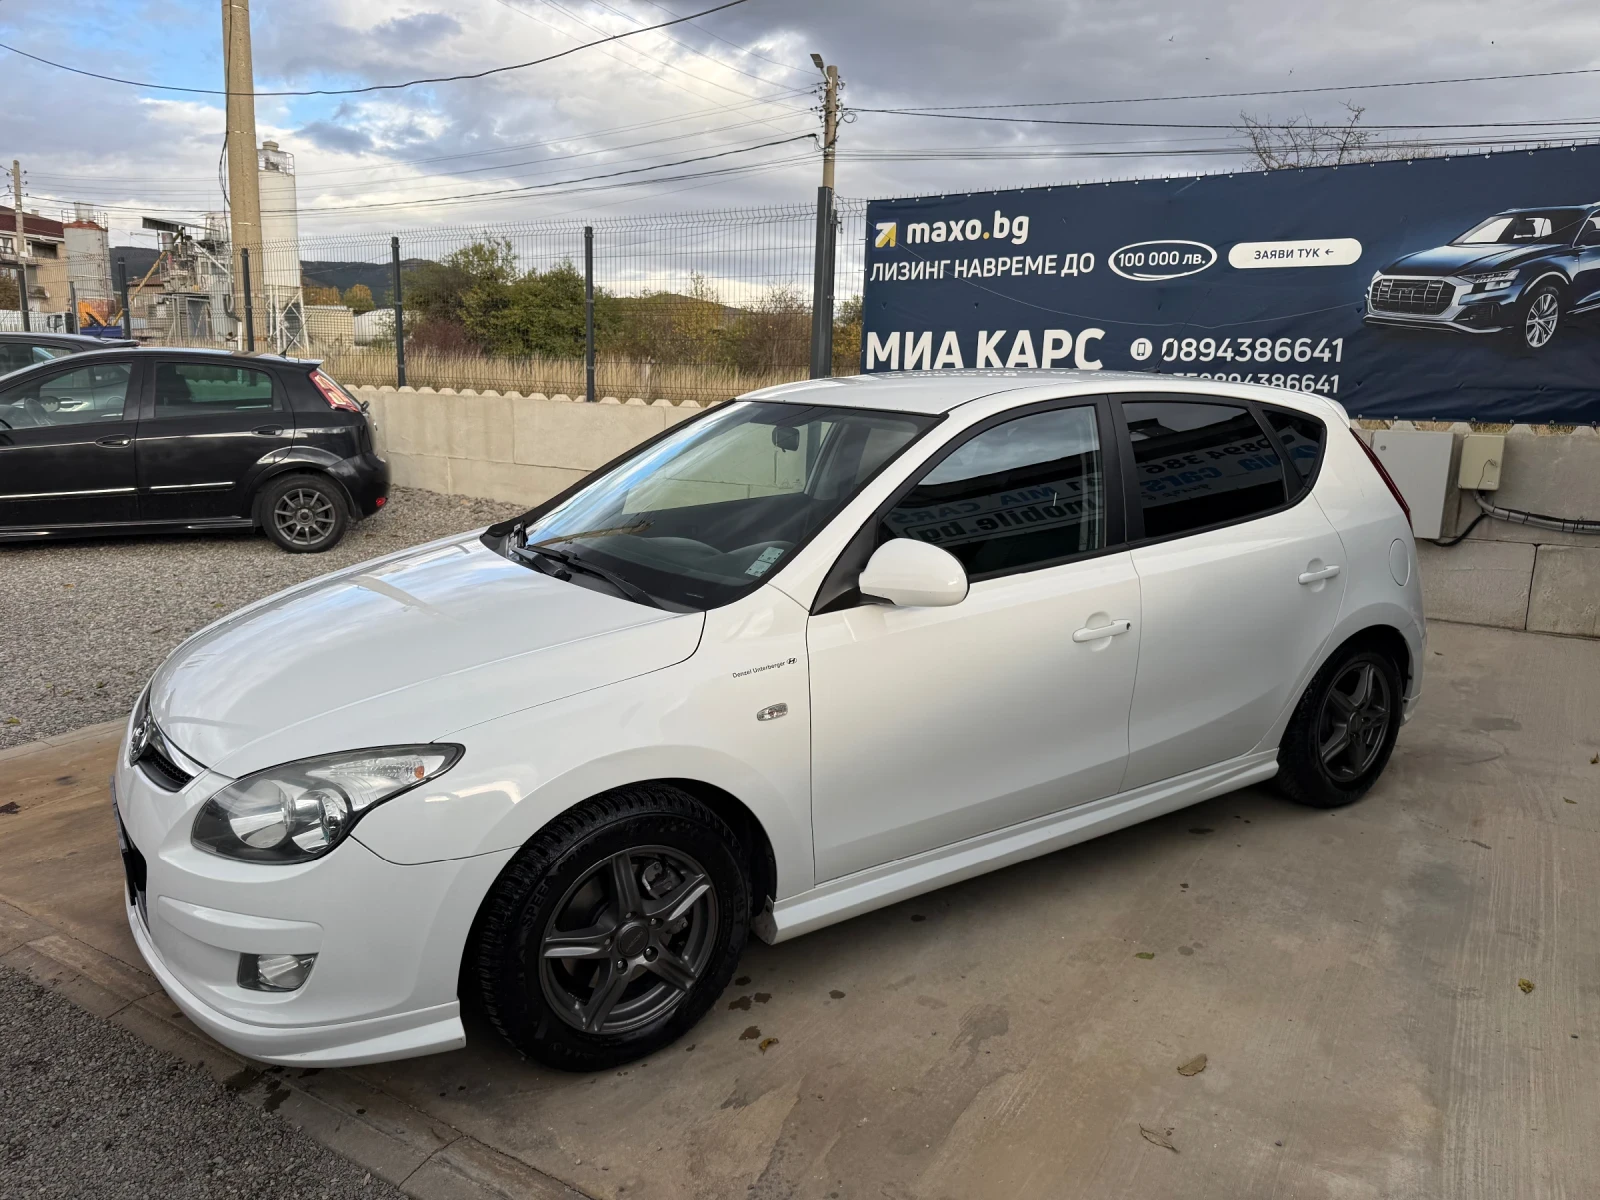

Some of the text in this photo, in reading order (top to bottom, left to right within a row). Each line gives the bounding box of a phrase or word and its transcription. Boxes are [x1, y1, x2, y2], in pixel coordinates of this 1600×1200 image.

[906, 210, 1029, 245] maxo.bg
[869, 252, 1095, 282] ЛИЗИНГ НАВРЕМЕ ДО
[1118, 251, 1206, 267] 100 000 лв.
[1253, 247, 1321, 261] ЗАЯВИ ТУК
[866, 328, 1106, 371] МИА КАРС
[1161, 337, 1344, 363] 0894386641
[732, 661, 785, 678] Denzel Unterberger
